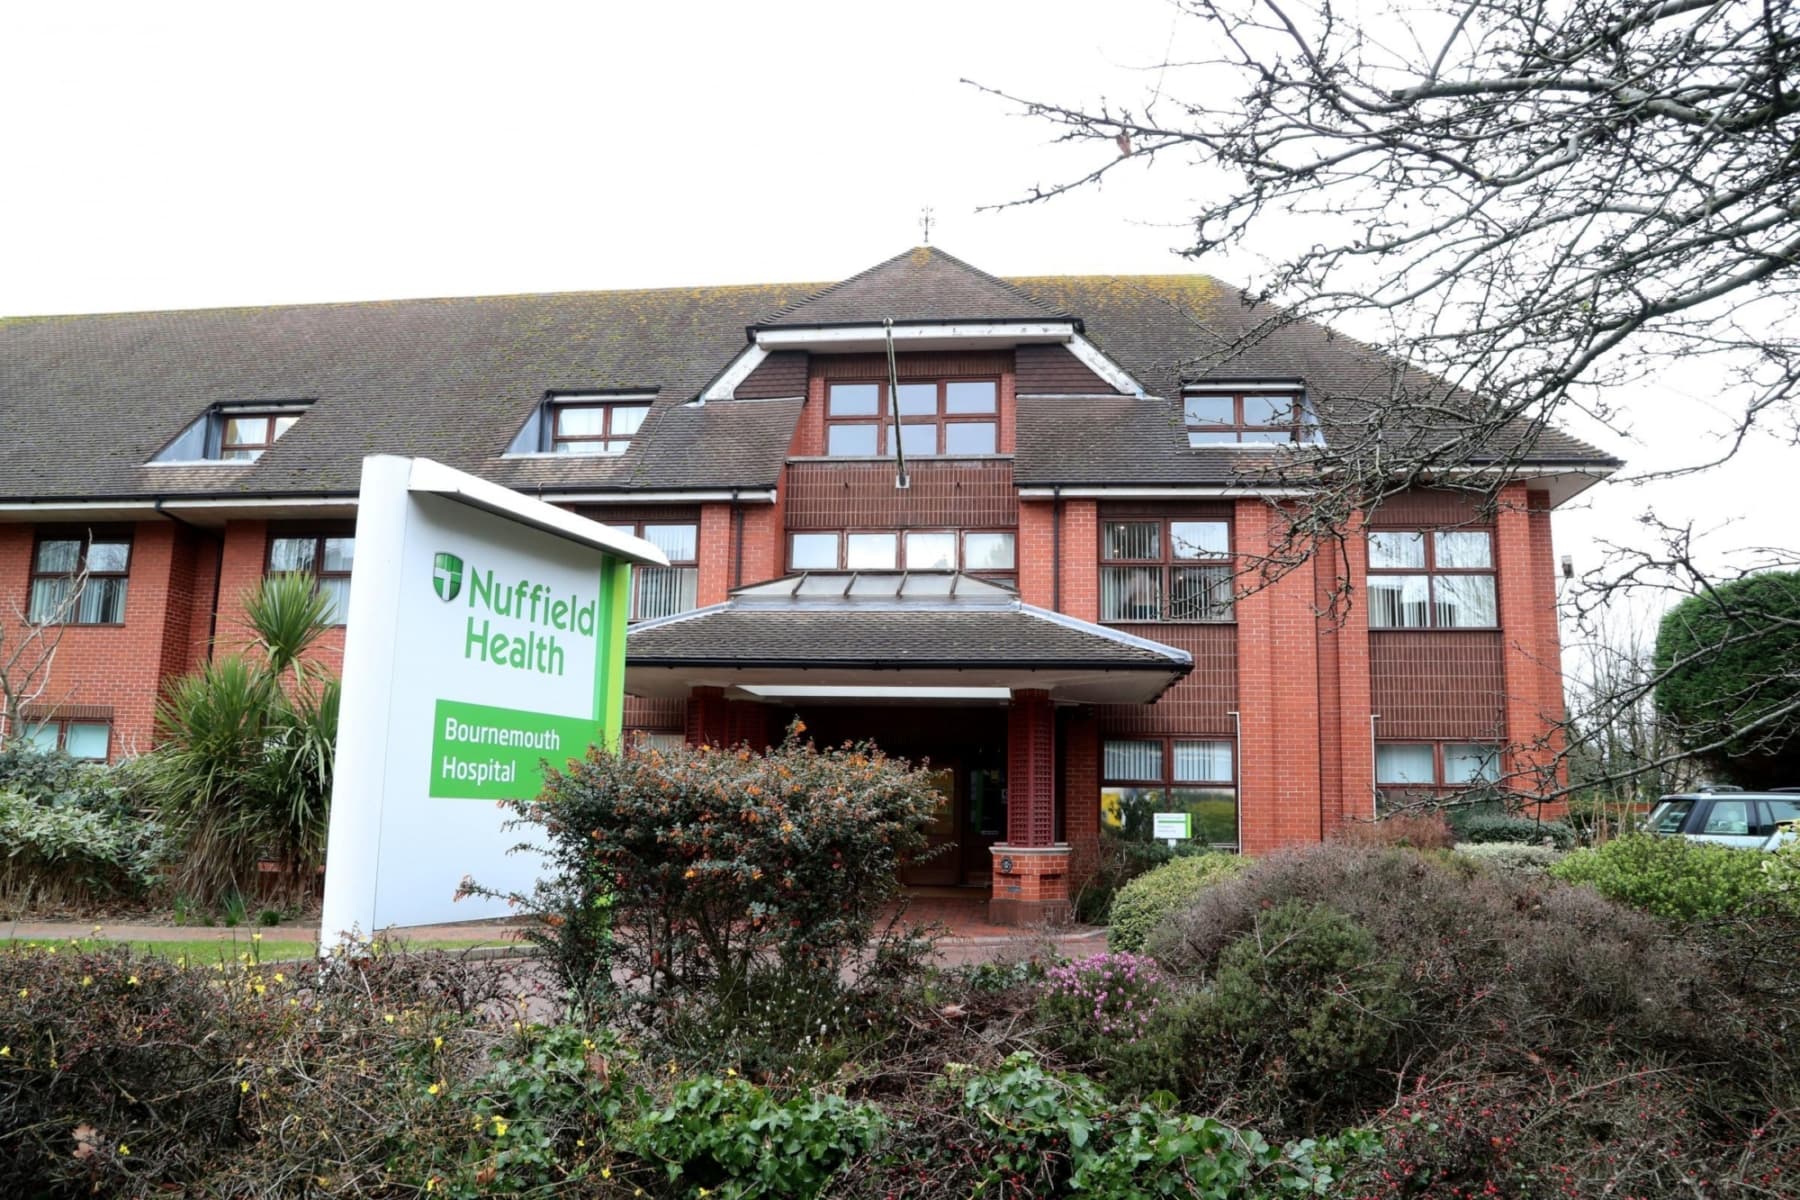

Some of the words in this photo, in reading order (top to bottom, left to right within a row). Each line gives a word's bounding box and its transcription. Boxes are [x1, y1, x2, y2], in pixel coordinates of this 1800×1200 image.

[469, 566, 595, 637] Nuffield
[465, 616, 564, 676] Health
[445, 717, 560, 750] Bournemouth
[442, 756, 515, 785] Hospital
